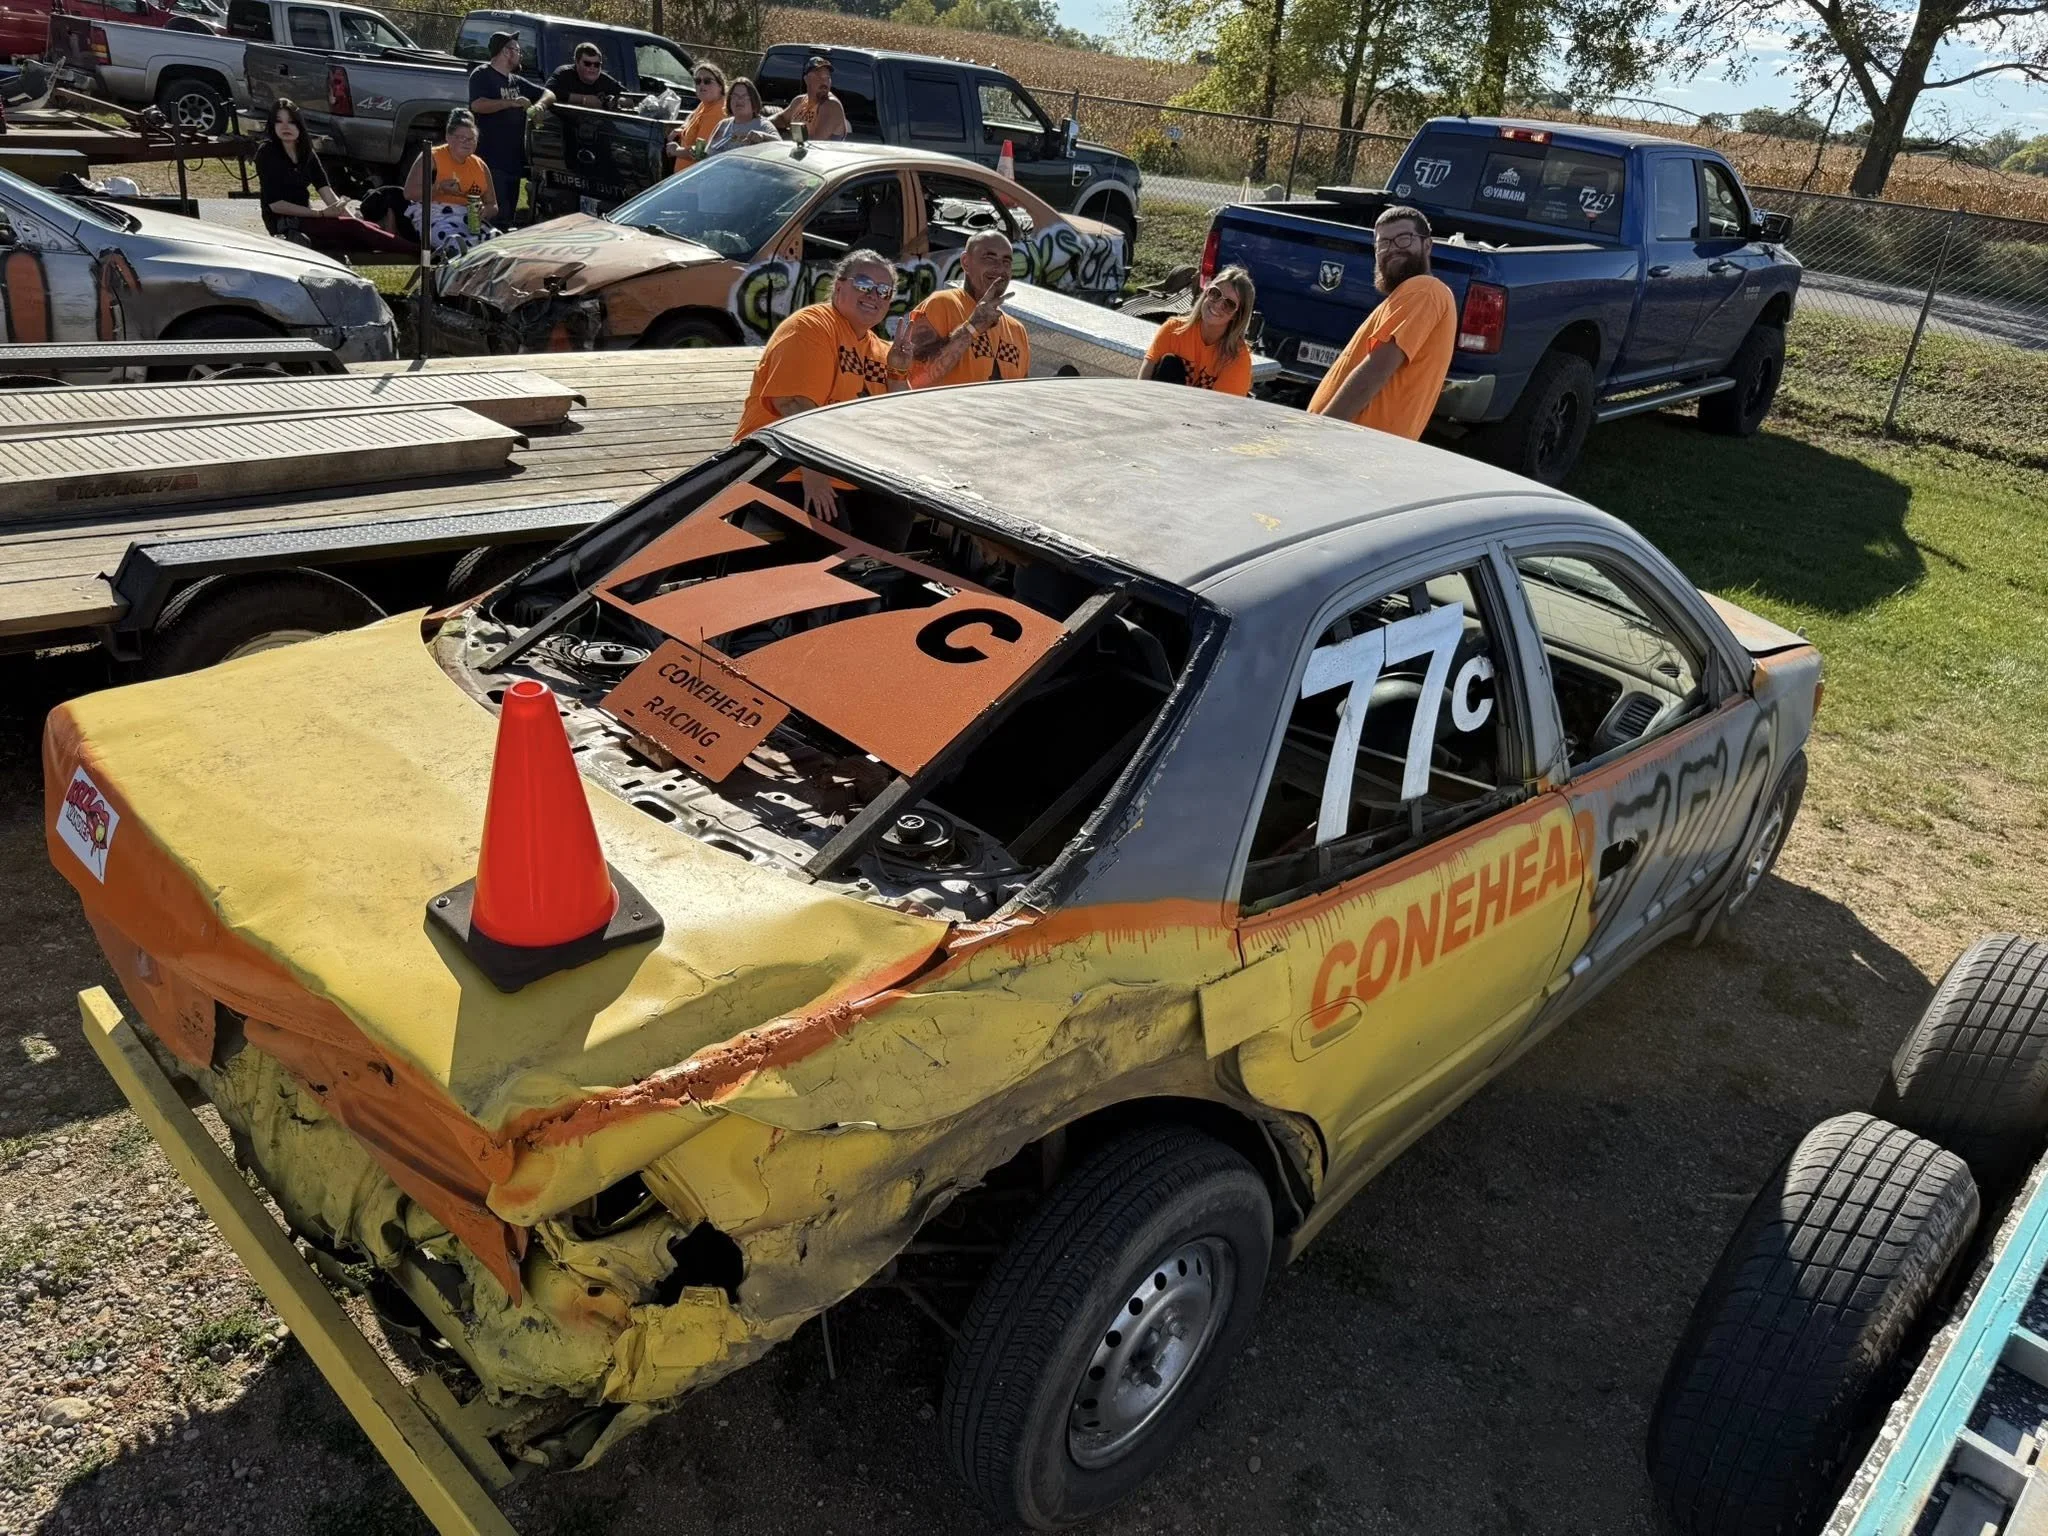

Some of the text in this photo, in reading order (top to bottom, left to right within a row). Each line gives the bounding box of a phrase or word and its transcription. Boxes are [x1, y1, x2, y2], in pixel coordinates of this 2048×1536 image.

[1415, 160, 1450, 187] 510
[1492, 187, 1526, 203] YAMAHA
[643, 694, 721, 750] RACING
[657, 660, 764, 731] CONEHEAD
[1309, 810, 1597, 1030] CONEHEAD
